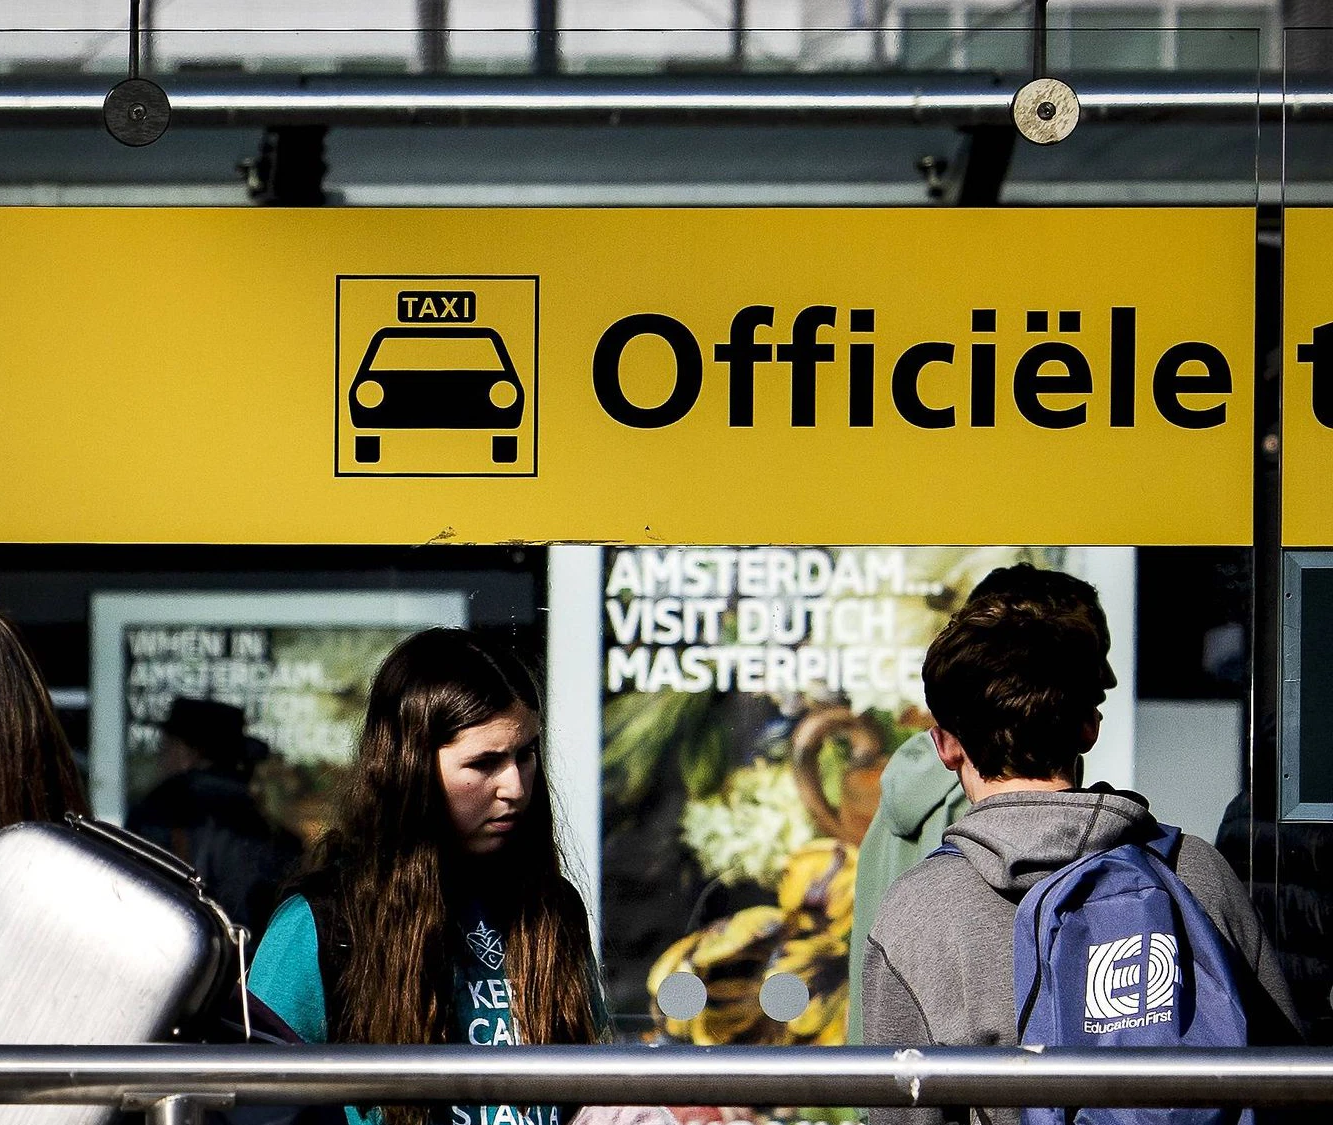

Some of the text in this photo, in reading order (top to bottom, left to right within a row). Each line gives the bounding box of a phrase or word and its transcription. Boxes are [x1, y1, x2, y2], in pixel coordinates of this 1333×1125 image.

[401, 297, 470, 318] TAXI
[591, 305, 1233, 430] Officiële
[605, 549, 945, 597] AMSTERDAM...
[126, 630, 265, 658] WHEN IN
[605, 598, 897, 645] VISIT DUTCH
[606, 645, 927, 694] MASTERPIECE
[1084, 1009, 1173, 1034] Education First
